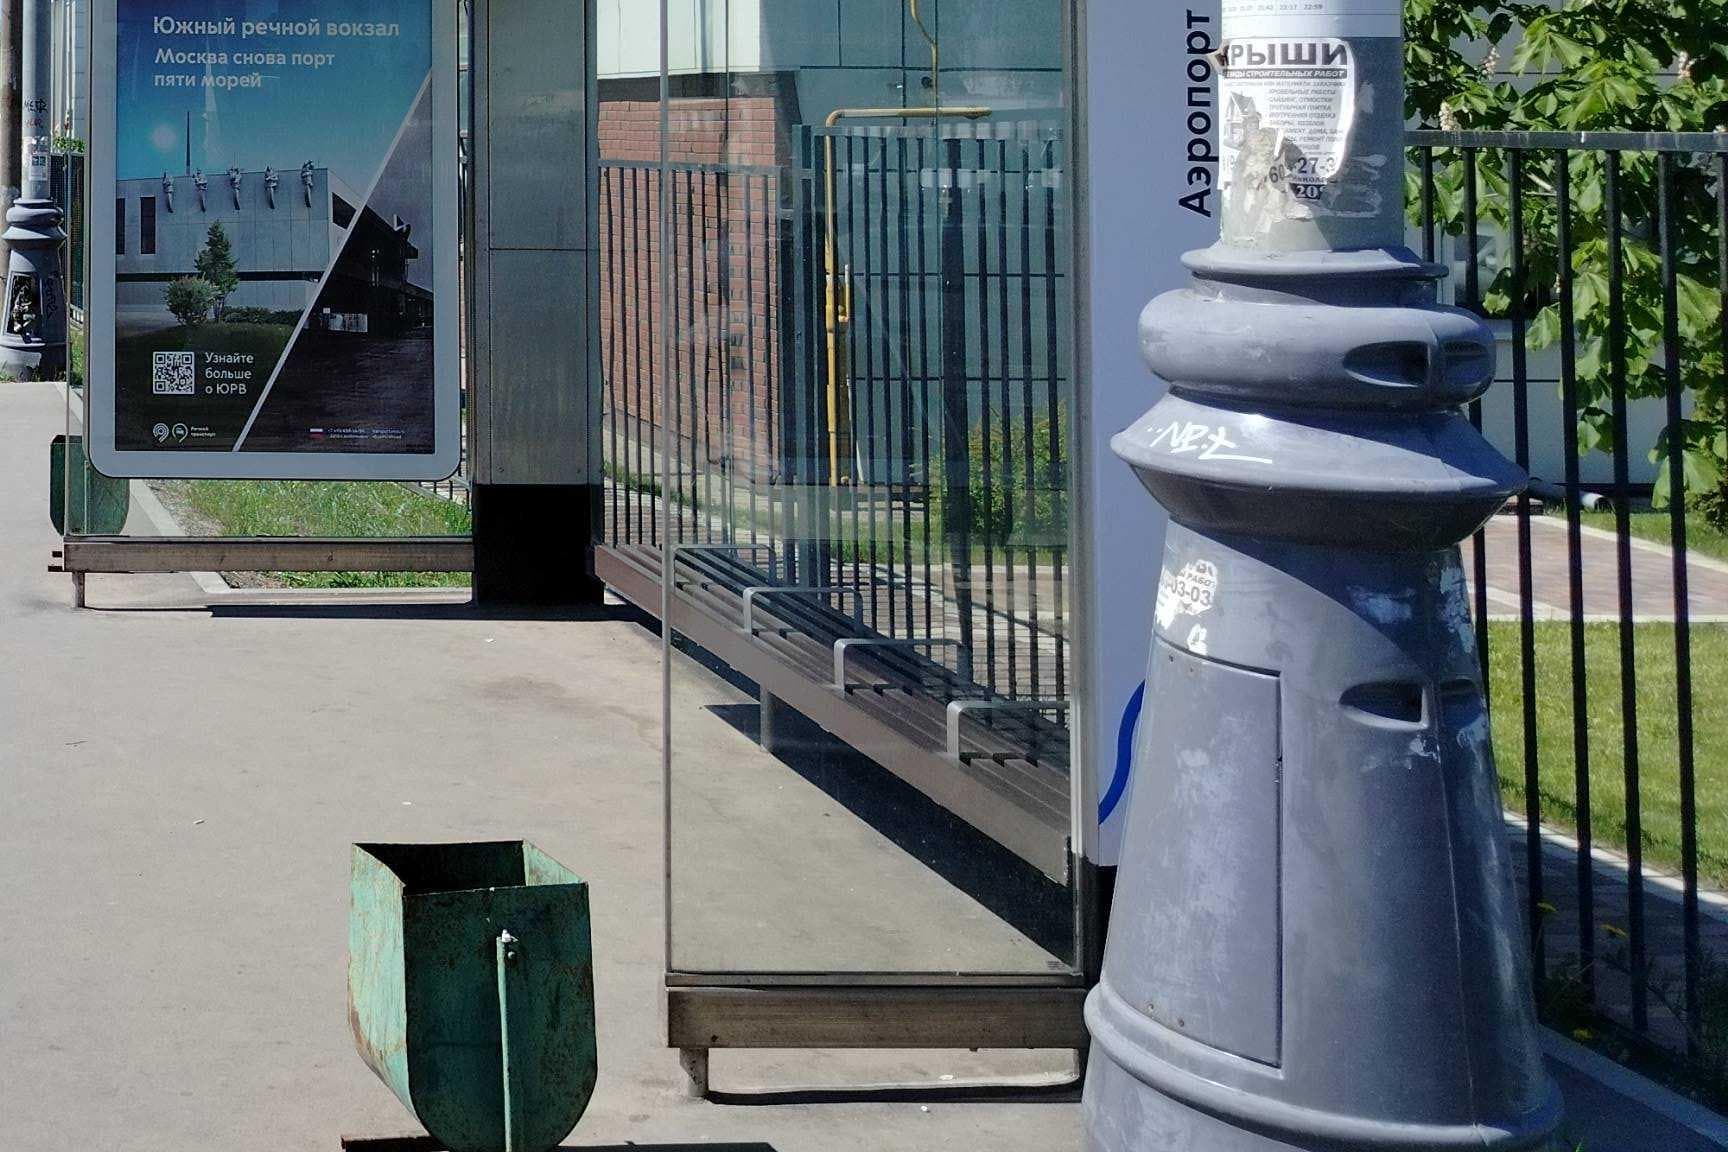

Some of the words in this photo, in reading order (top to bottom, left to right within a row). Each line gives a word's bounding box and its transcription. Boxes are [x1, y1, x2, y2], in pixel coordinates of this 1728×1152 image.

[153, 16, 235, 36] Южный
[242, 19, 320, 38] речной
[327, 22, 400, 37] вокзал
[155, 48, 228, 65] Москва
[233, 53, 286, 65] снова
[291, 51, 335, 70] порт
[1228, 42, 1348, 65] РЫШИ
[154, 74, 196, 88] пяти
[201, 72, 262, 91] морей
[1178, 9, 1220, 217] Аэропорт
[205, 352, 254, 366] Узнайте
[205, 367, 252, 380] больше
[205, 386, 213, 395] о
[216, 384, 246, 395] ЮРВ
